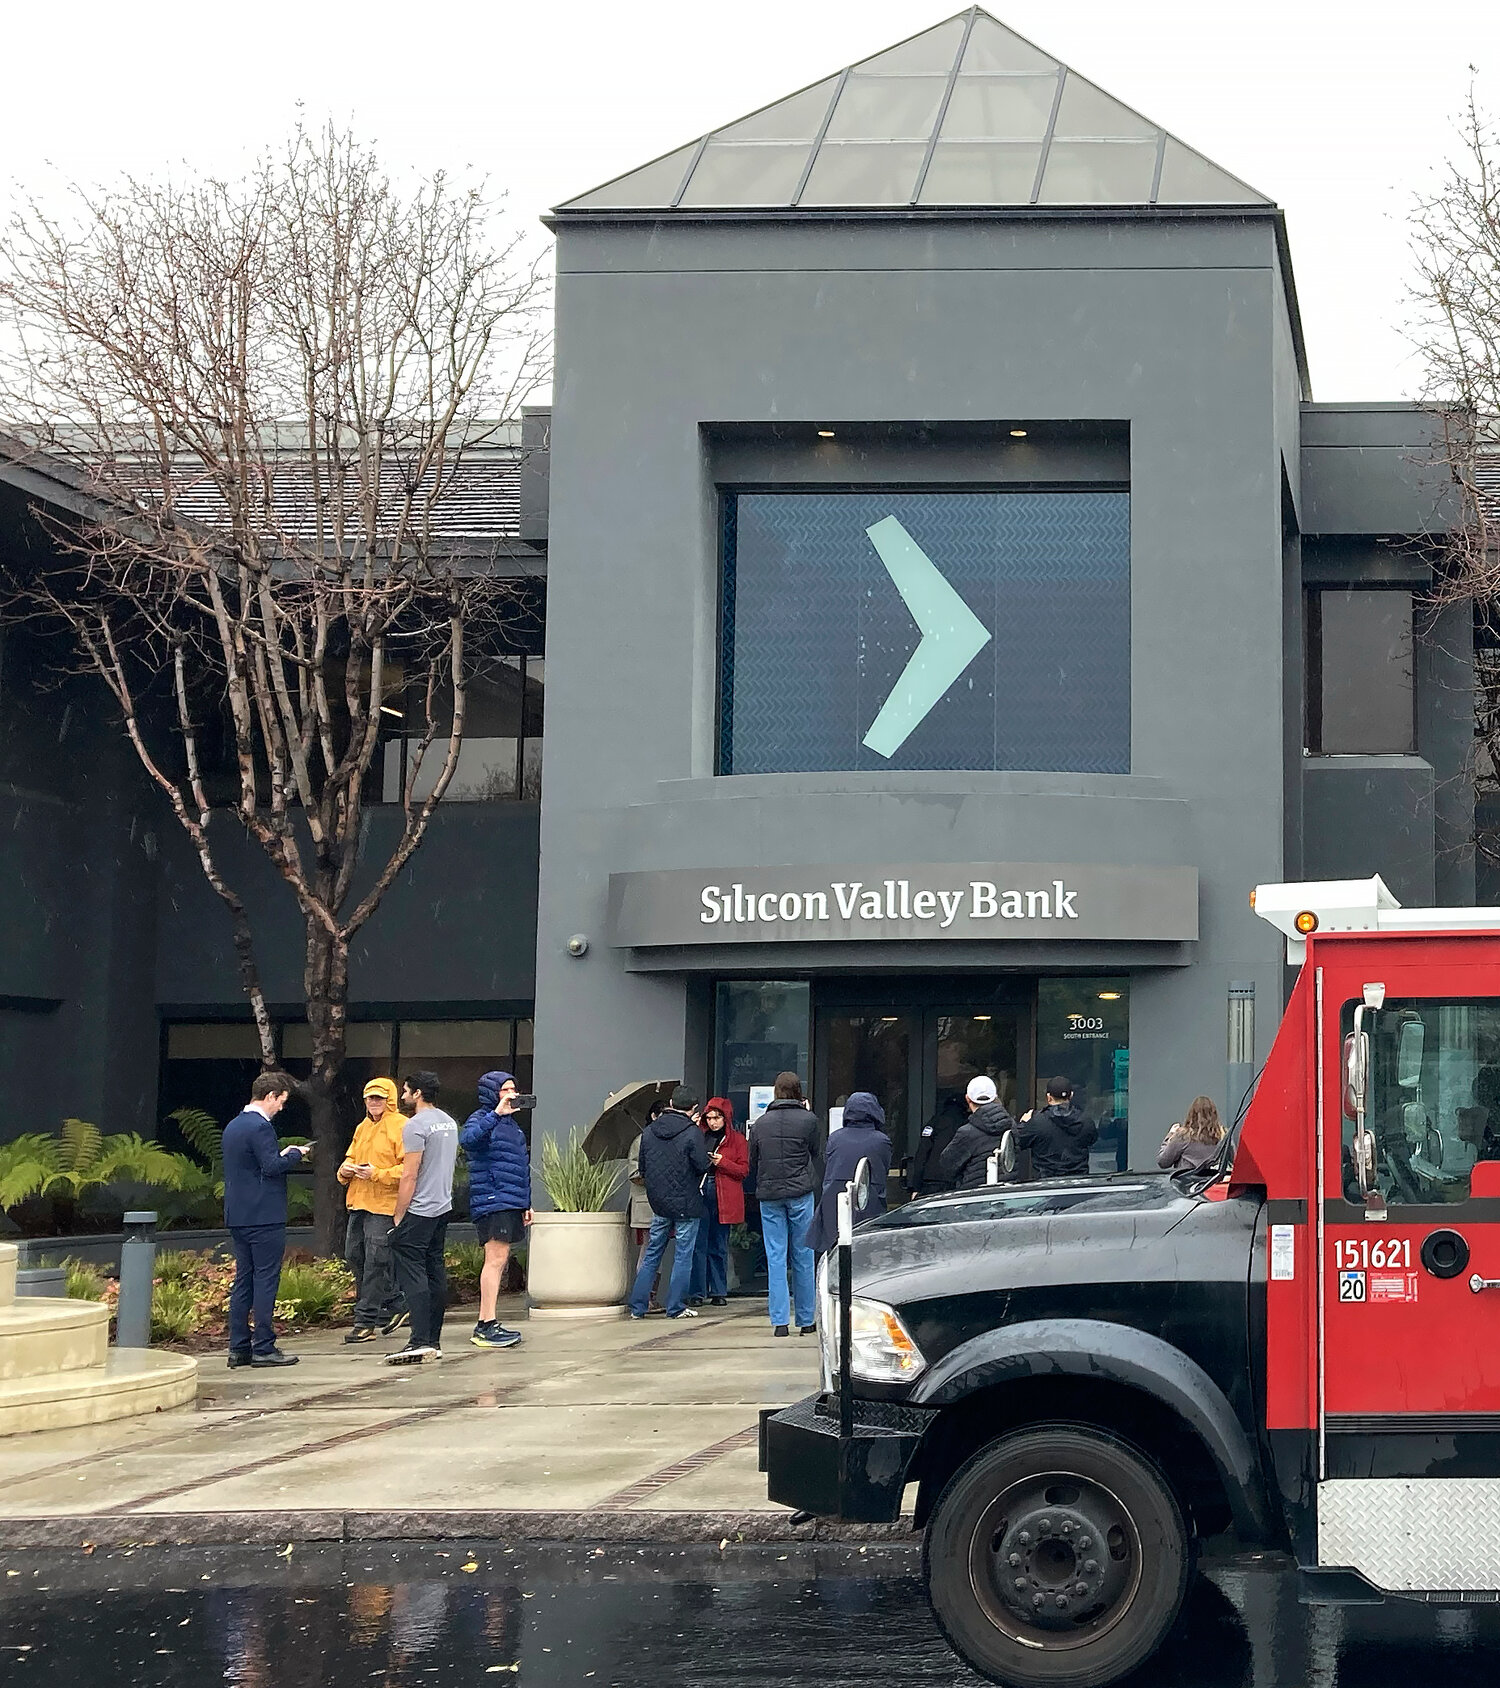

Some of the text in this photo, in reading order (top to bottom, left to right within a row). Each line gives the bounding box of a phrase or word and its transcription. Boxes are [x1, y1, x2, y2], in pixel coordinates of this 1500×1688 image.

[700, 880, 1079, 927] Silicon Valley Bank
[1069, 1017, 1103, 1030] 3003
[1334, 1239, 1410, 1268] 151621
[1341, 1279, 1364, 1300] 20
